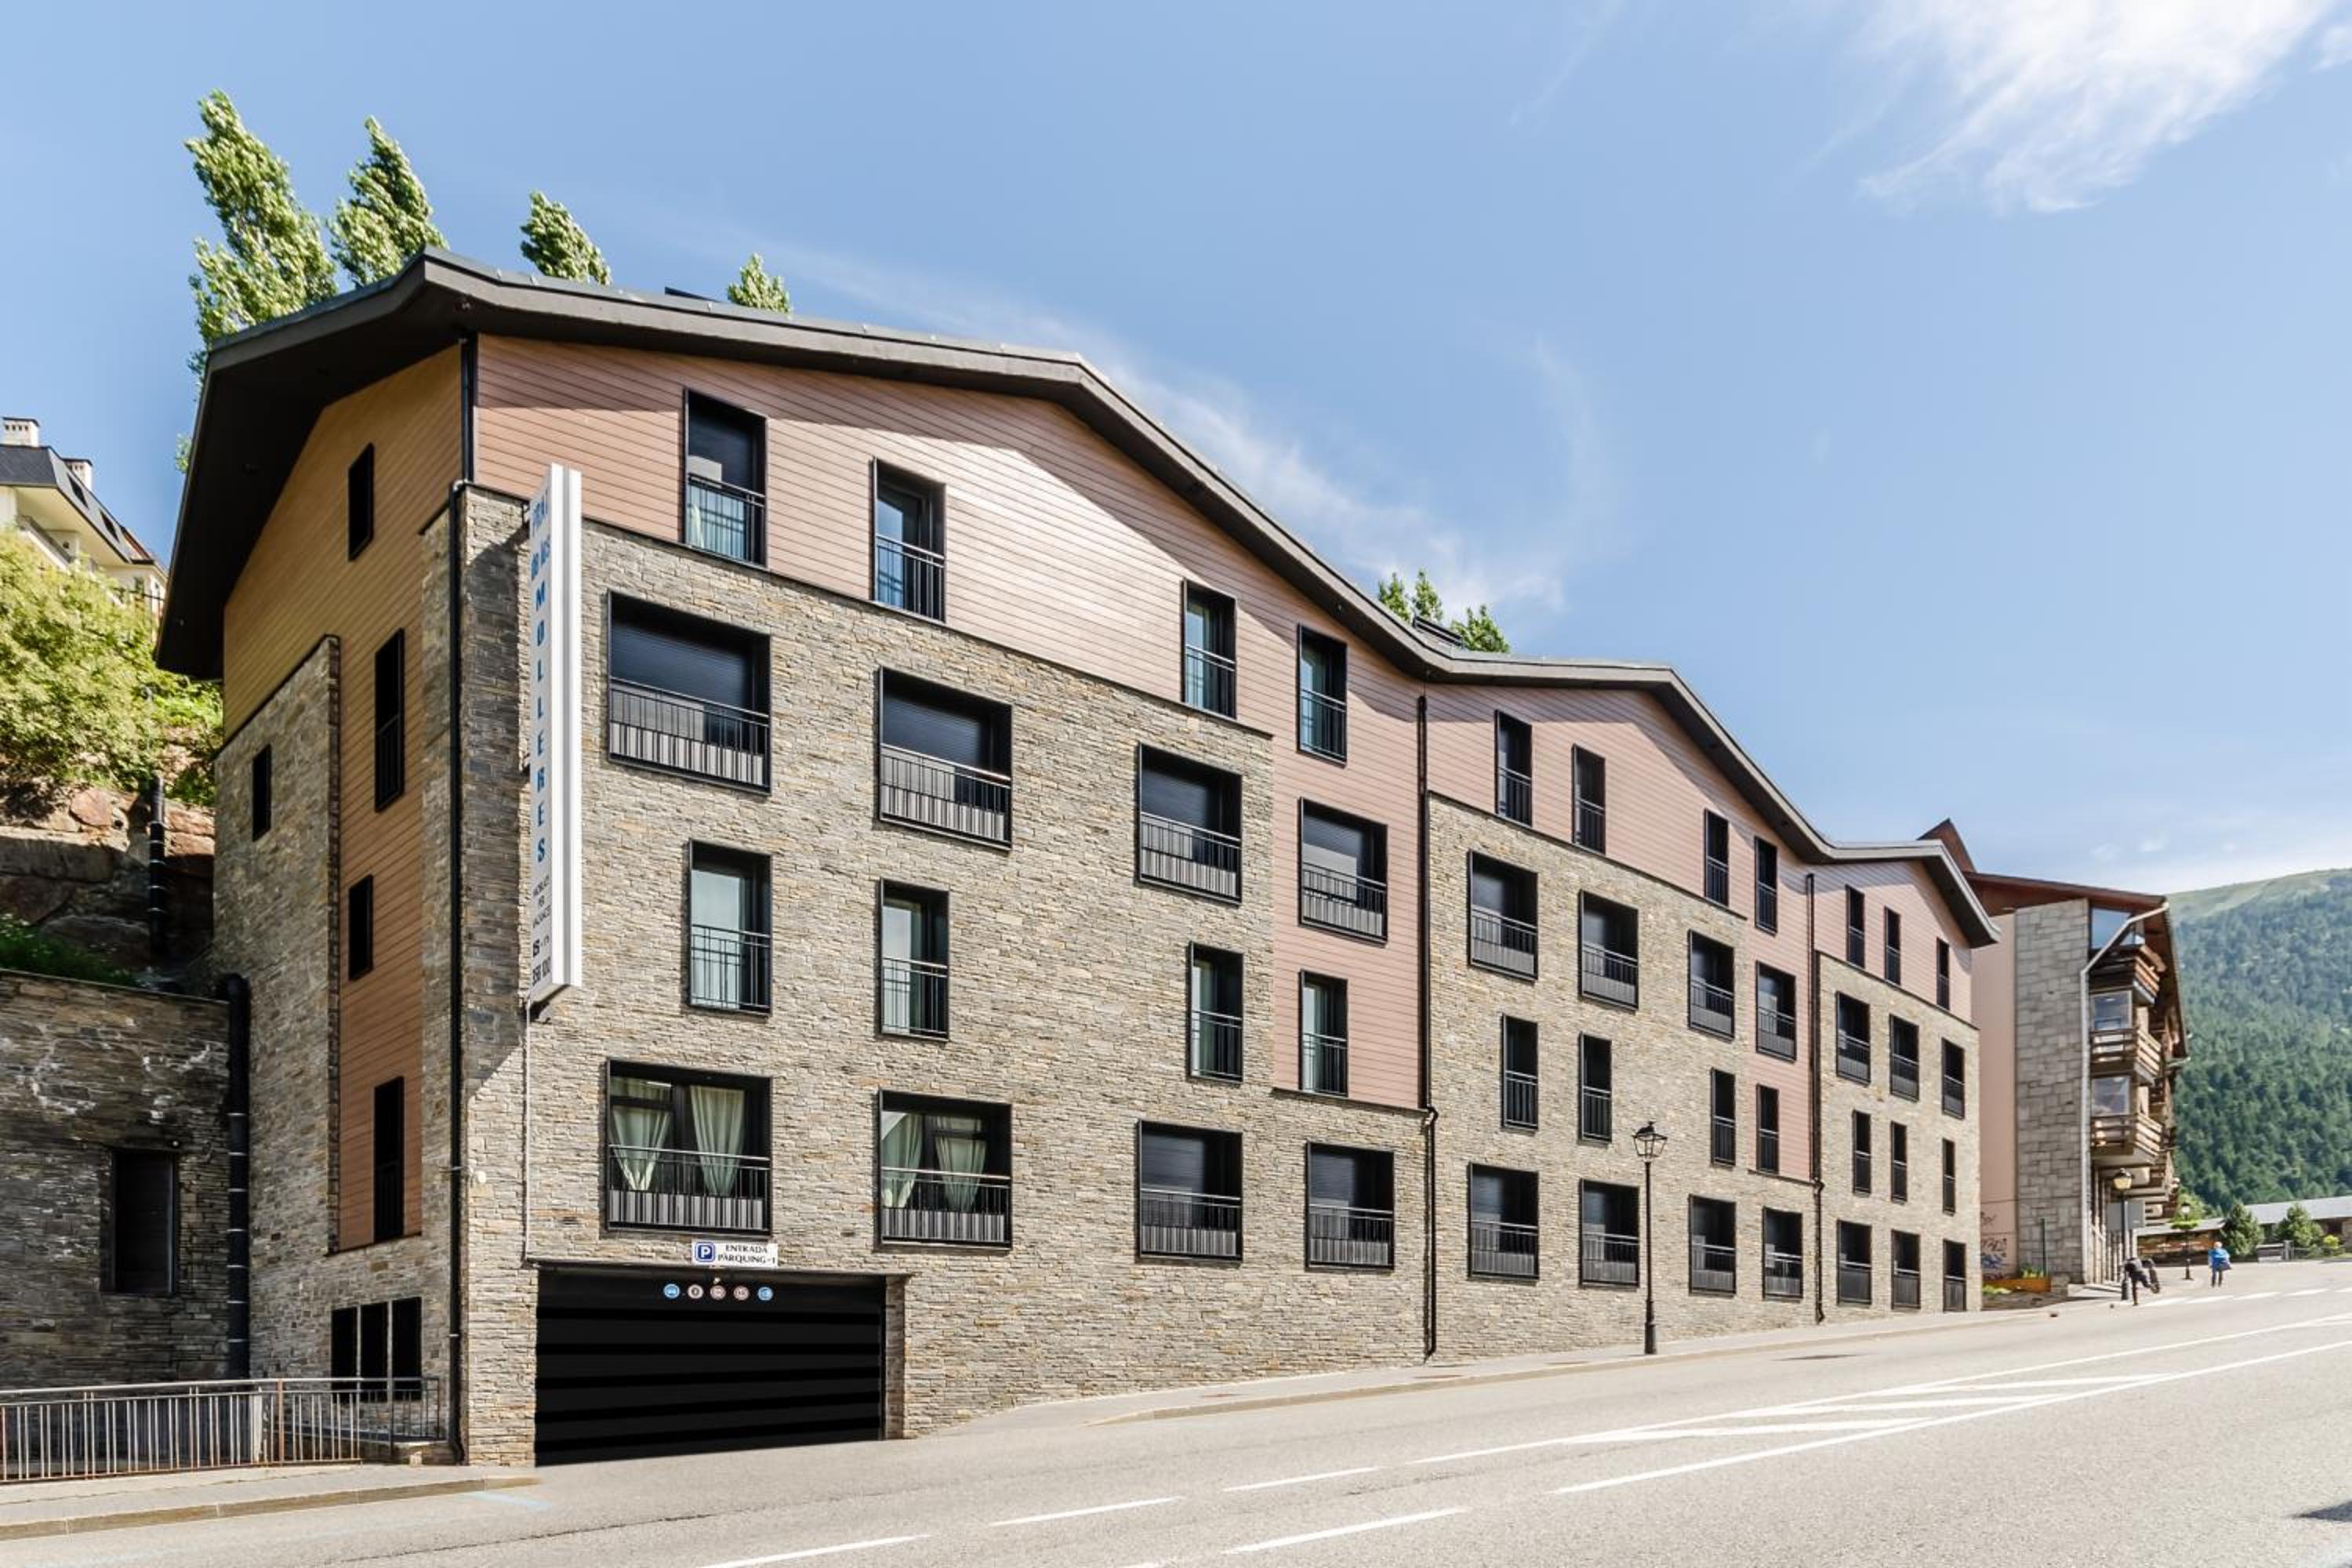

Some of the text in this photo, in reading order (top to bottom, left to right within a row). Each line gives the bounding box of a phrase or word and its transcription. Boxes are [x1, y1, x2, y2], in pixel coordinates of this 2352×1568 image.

[535, 580, 546, 863] MOLLERES
[700, 1247, 711, 1259] P
[725, 1244, 768, 1254] ENTRADA
